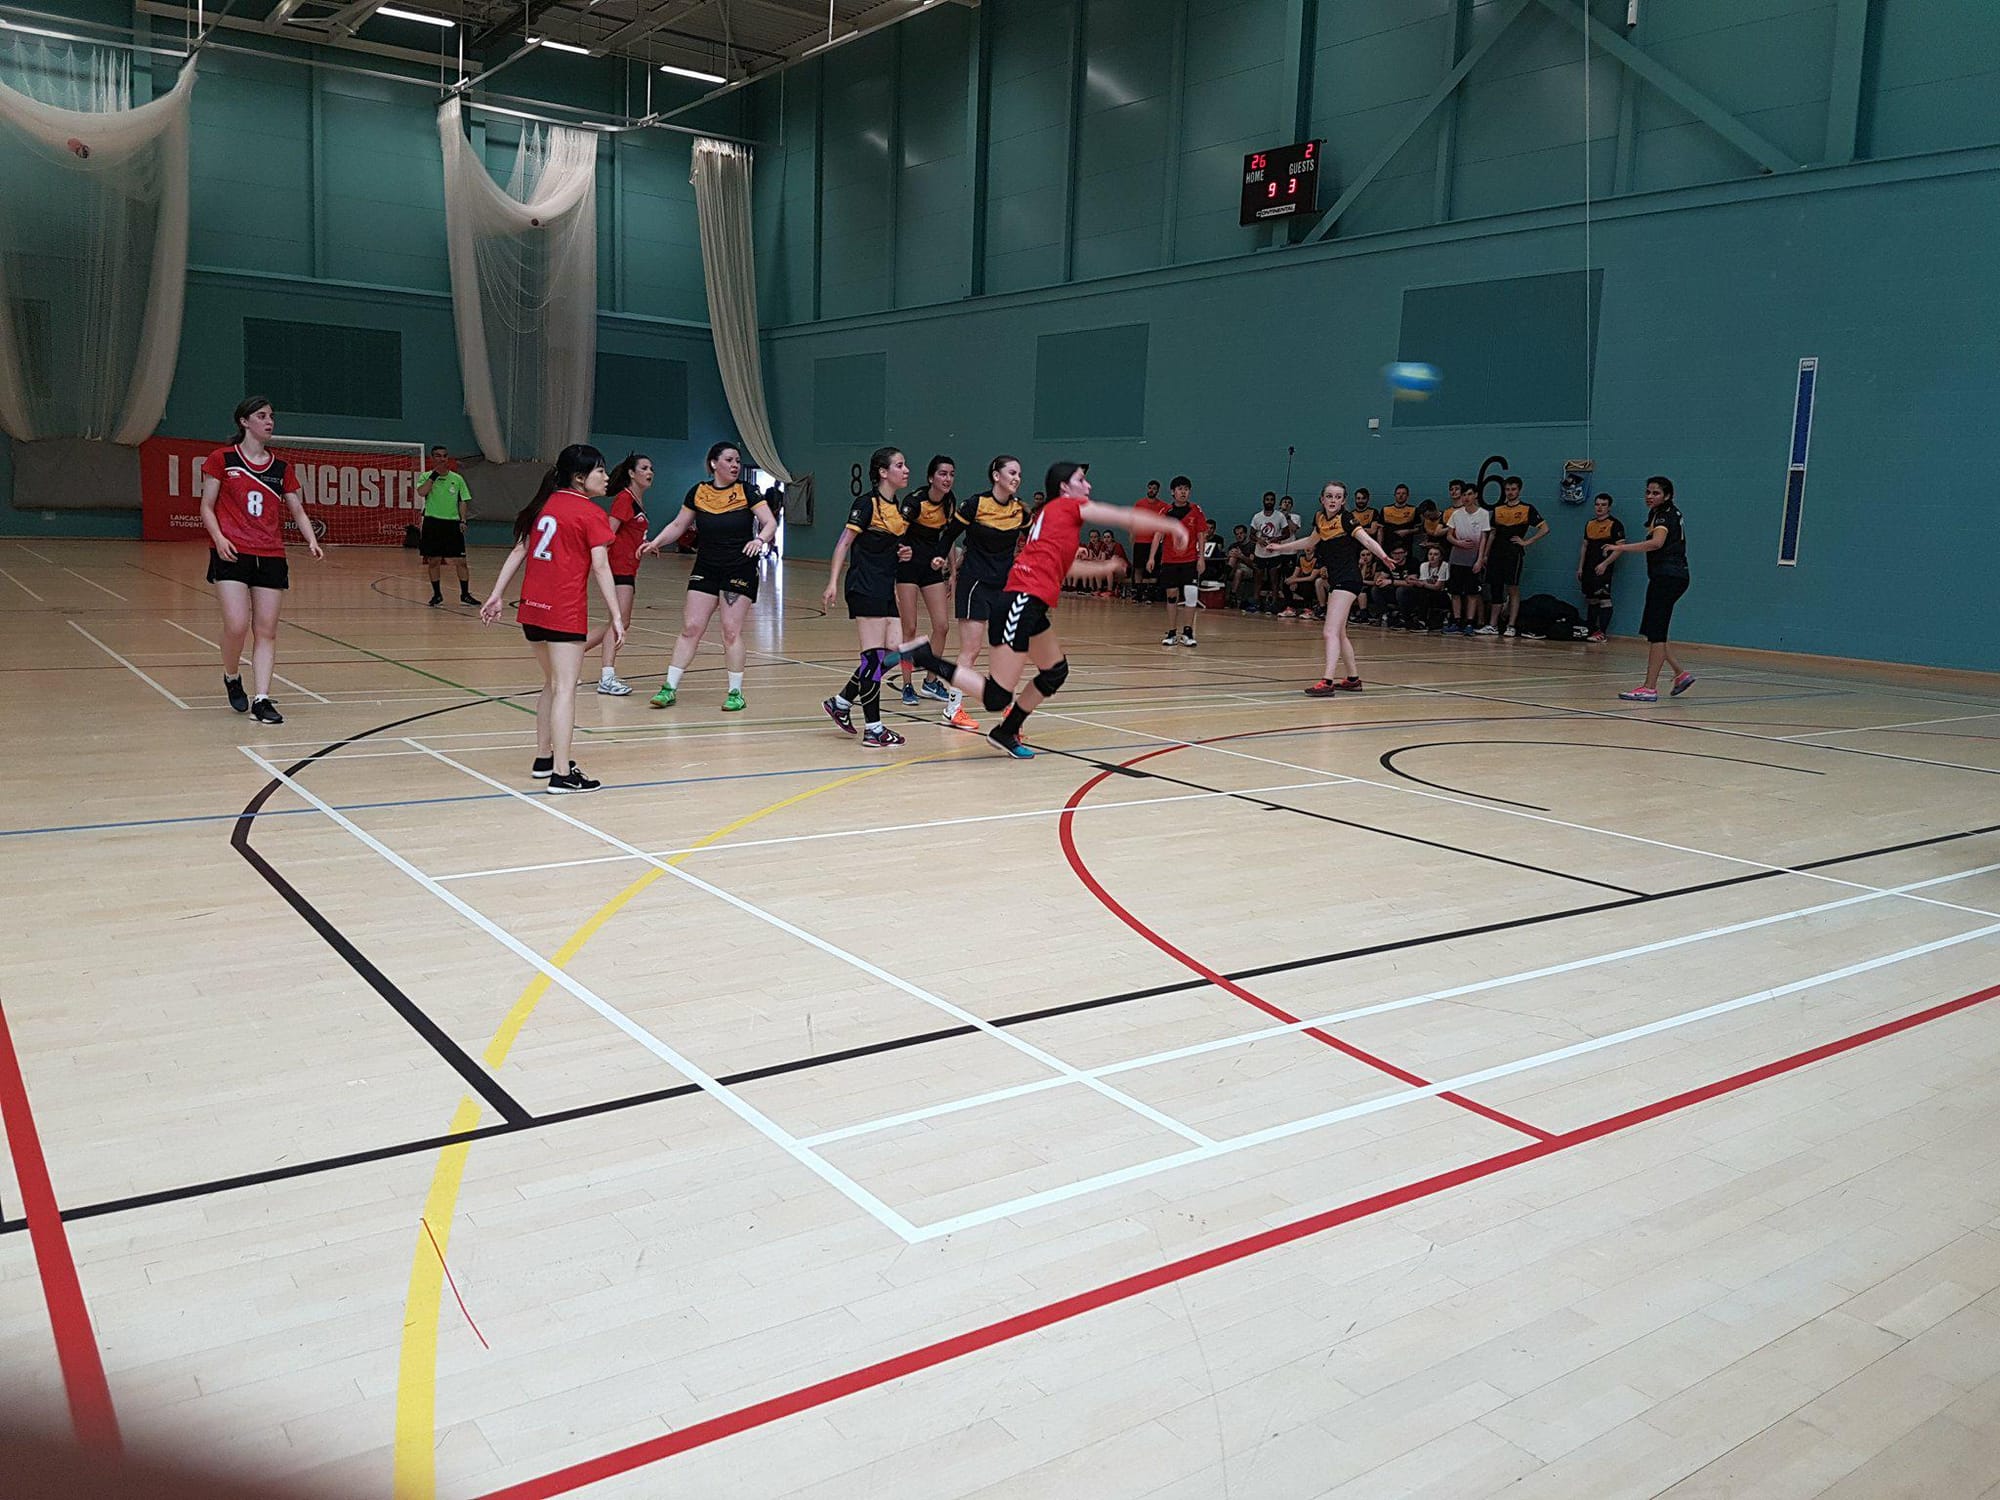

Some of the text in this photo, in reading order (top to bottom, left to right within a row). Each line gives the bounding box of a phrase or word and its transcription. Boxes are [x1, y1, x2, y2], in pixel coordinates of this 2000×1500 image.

[1305, 143, 1314, 158] 2
[1251, 154, 1266, 169] 26
[1288, 159, 1315, 175] GUESTS
[1245, 169, 1264, 184] HOME
[1268, 178, 1296, 197] 9 3
[1256, 204, 1296, 218] CONTINENTAL
[168, 455, 179, 496] I
[294, 463, 422, 510] NCASTE
[851, 463, 862, 496] 8
[1477, 456, 1508, 511] 6
[247, 491, 263, 517] 8
[169, 514, 203, 522] LANCAST
[532, 515, 557, 561] 2
